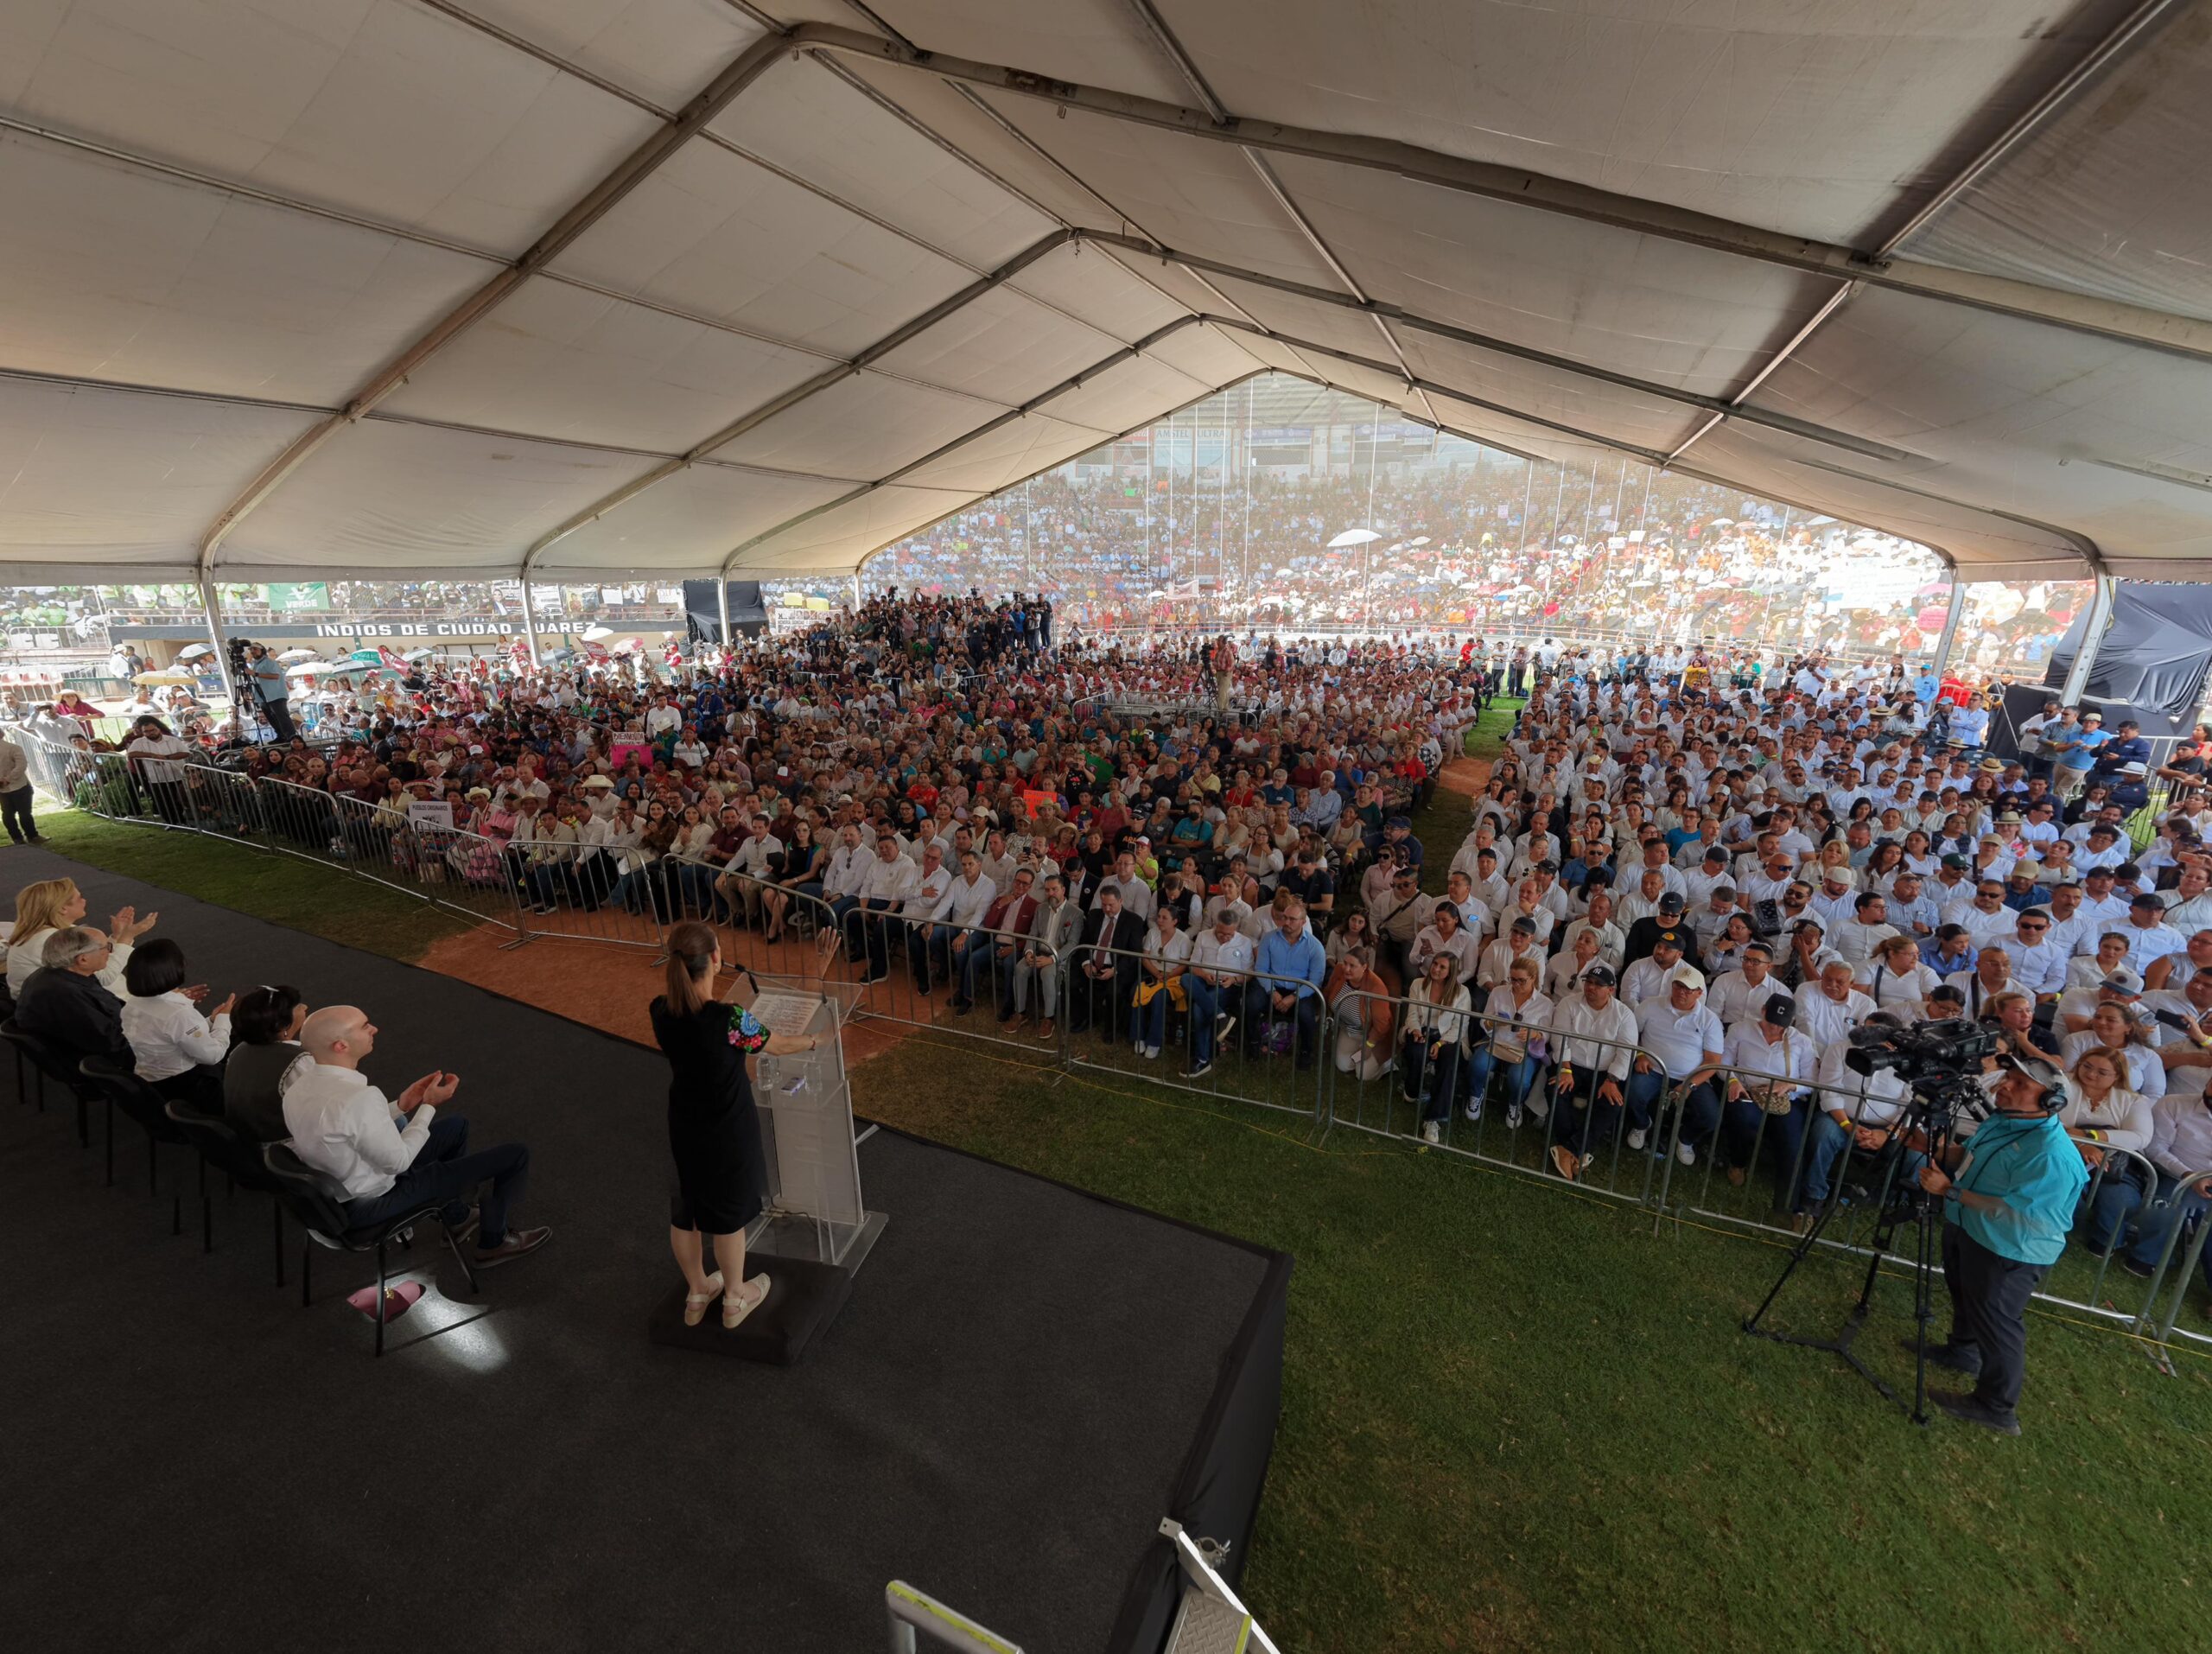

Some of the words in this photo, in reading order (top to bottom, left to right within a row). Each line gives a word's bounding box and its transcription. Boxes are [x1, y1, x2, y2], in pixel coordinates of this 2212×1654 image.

[285, 599, 318, 608] VERDE
[316, 624, 392, 637] INDIOS
[400, 624, 429, 636] DE
[436, 623, 512, 635] CIUDAD
